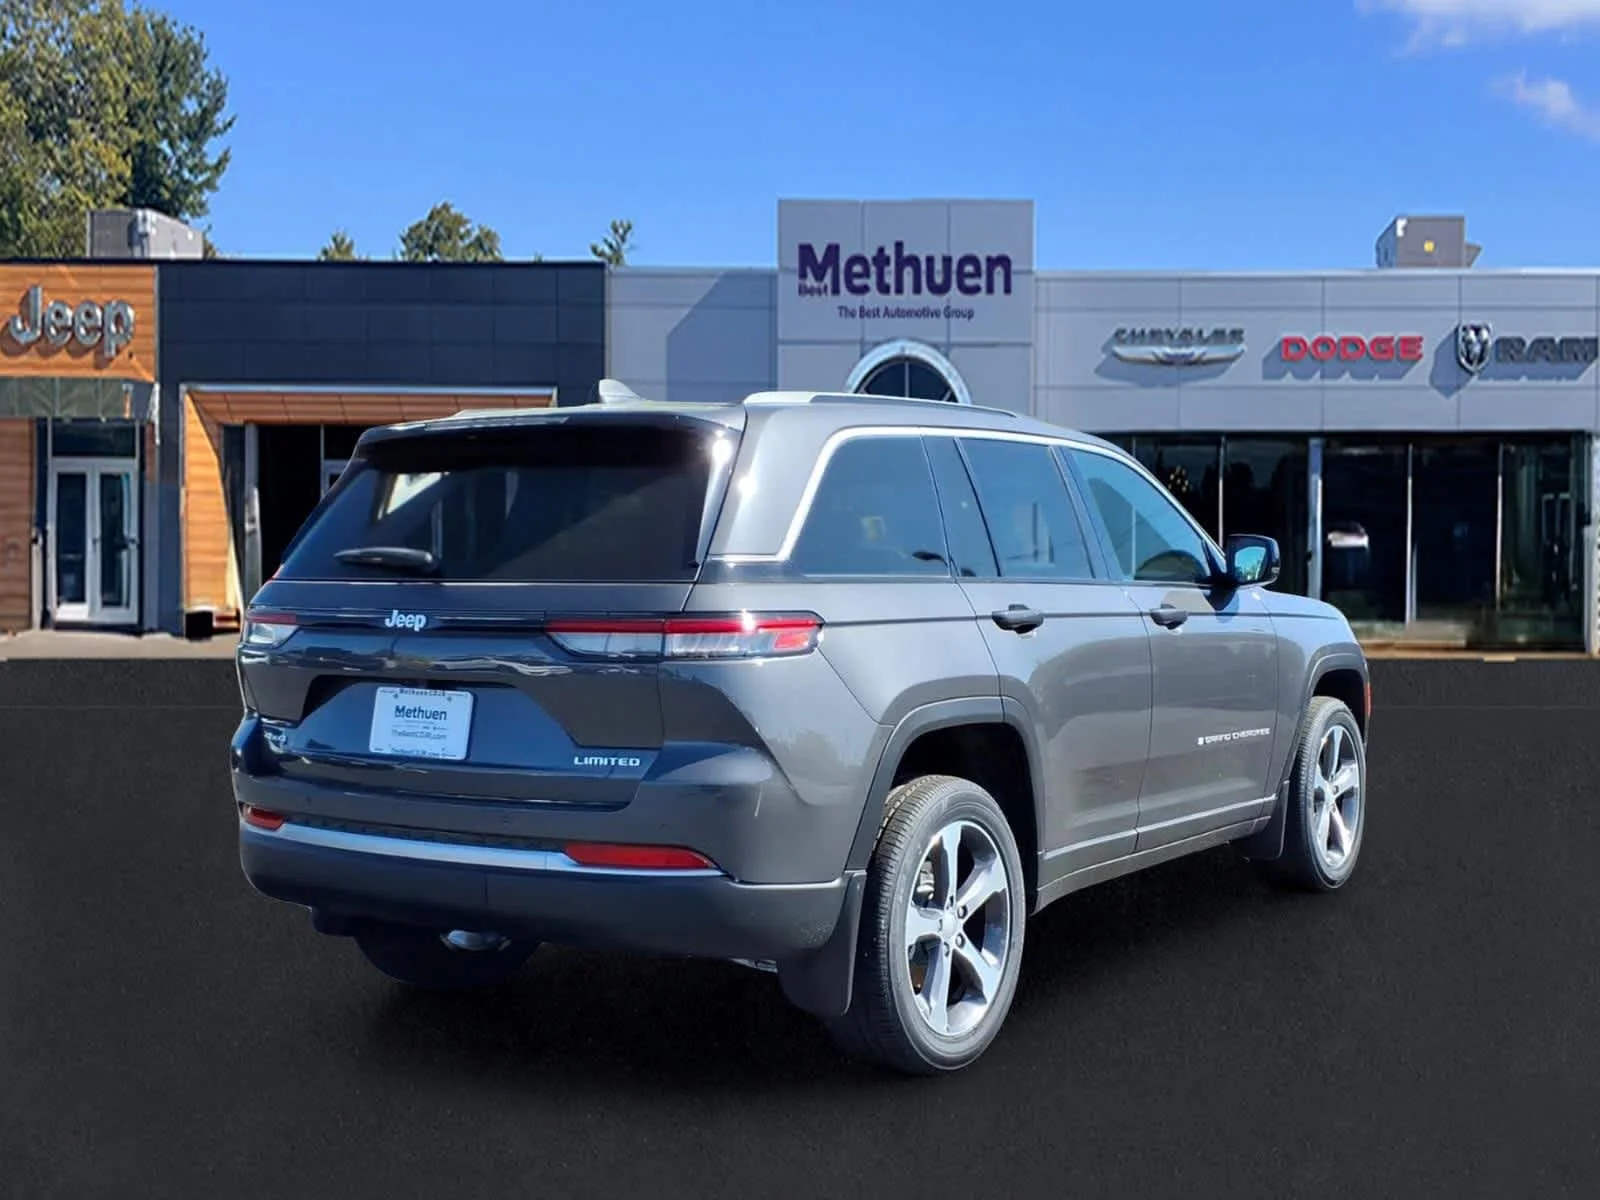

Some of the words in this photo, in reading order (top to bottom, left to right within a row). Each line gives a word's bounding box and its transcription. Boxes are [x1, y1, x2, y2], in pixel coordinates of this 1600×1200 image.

[798, 240, 1012, 296] Methuen
[9, 284, 136, 358] Jeep
[837, 305, 857, 319] The
[858, 305, 881, 319] Best
[882, 305, 942, 319] Automotive
[943, 305, 975, 321] Group
[1280, 335, 1424, 361] DODGE
[1495, 336, 1599, 362] RAM
[384, 609, 427, 632] Jeep
[394, 704, 448, 721] Methuen
[573, 755, 641, 768] LIMITED
